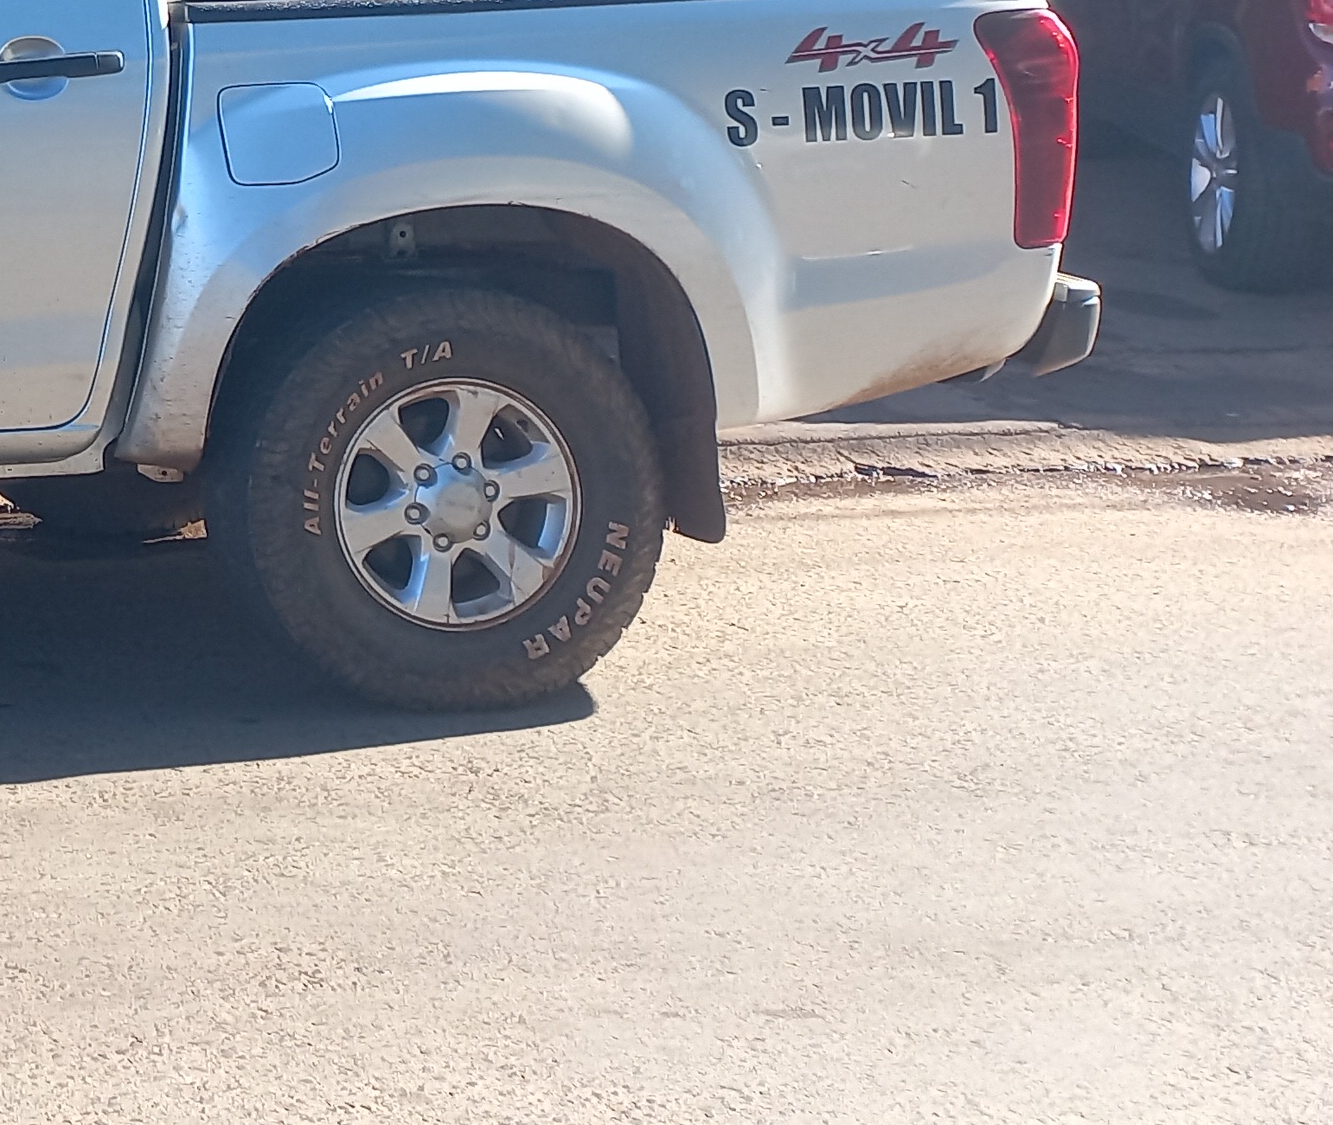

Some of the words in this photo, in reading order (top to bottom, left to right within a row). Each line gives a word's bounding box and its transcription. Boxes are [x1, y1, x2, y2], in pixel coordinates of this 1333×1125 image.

[726, 88, 758, 147] S
[802, 80, 963, 143] MOVIL
[973, 77, 999, 134] 1
[303, 371, 385, 536] All-Terrain
[400, 340, 453, 370] T/A
[521, 520, 631, 661] NEUPAR
